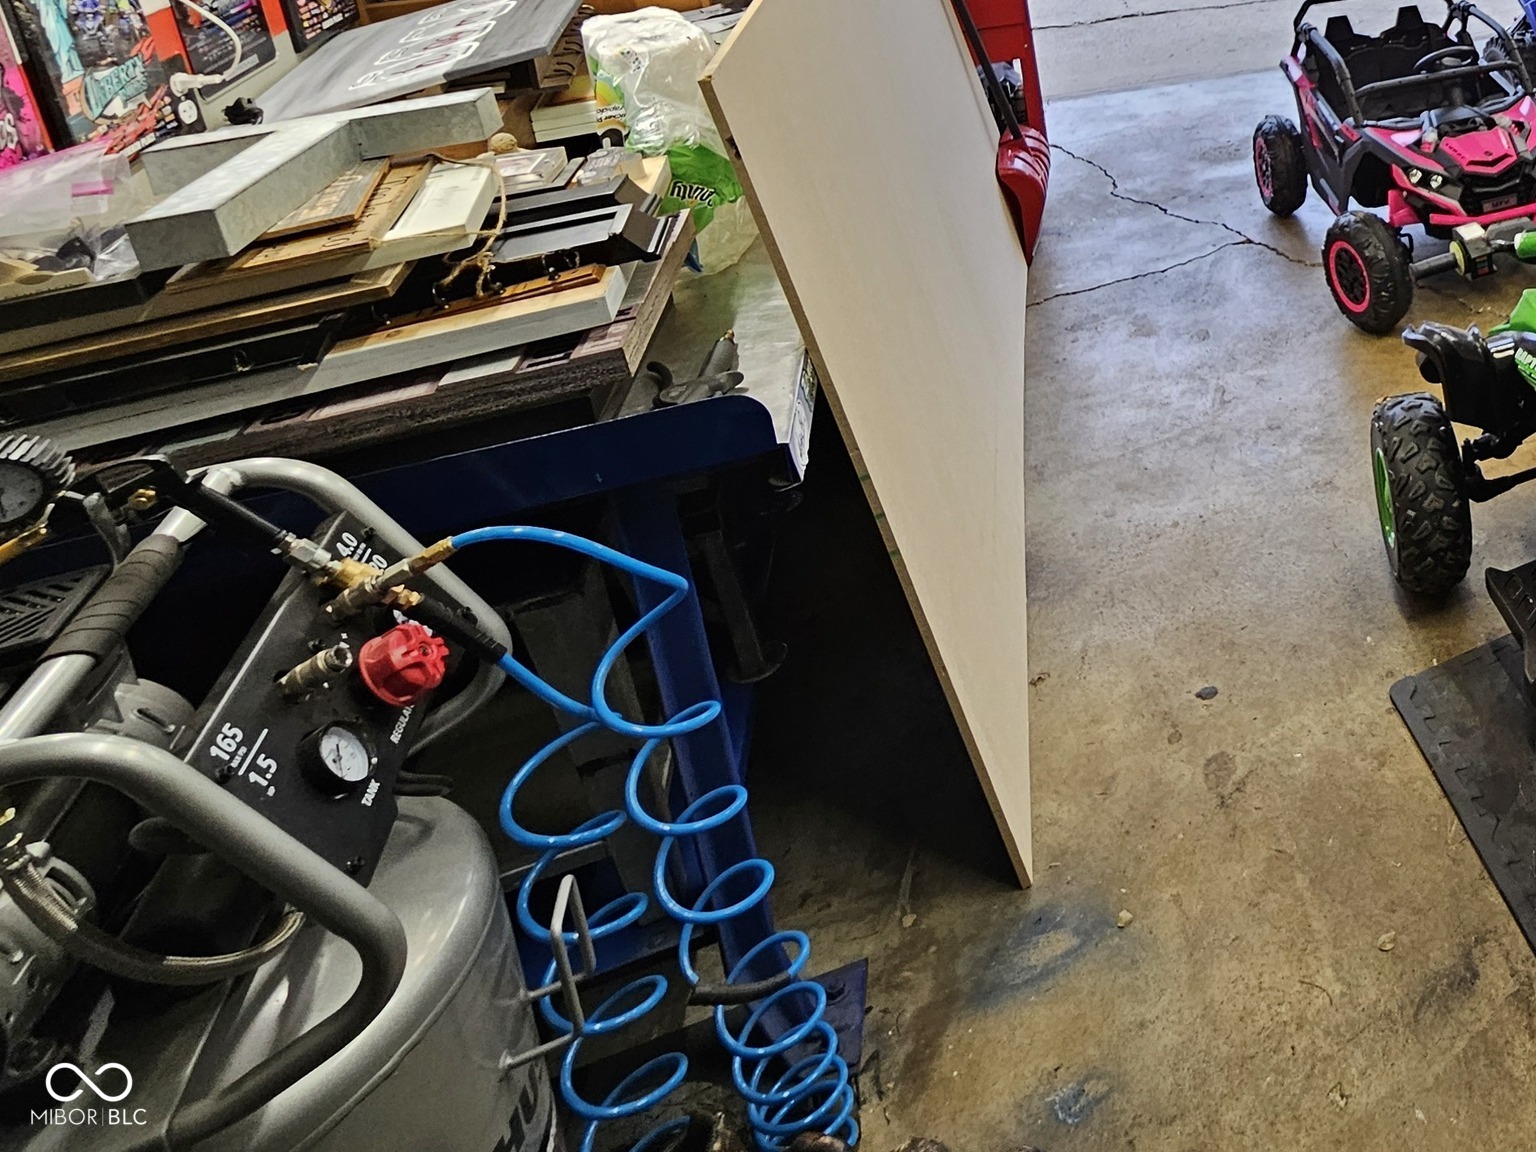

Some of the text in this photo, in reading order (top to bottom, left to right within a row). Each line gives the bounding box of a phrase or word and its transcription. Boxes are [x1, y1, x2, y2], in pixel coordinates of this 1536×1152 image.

[335, 531, 358, 558] 4.0
[210, 721, 245, 762] 165
[249, 753, 278, 787] 1.5
[360, 778, 381, 807] TANK
